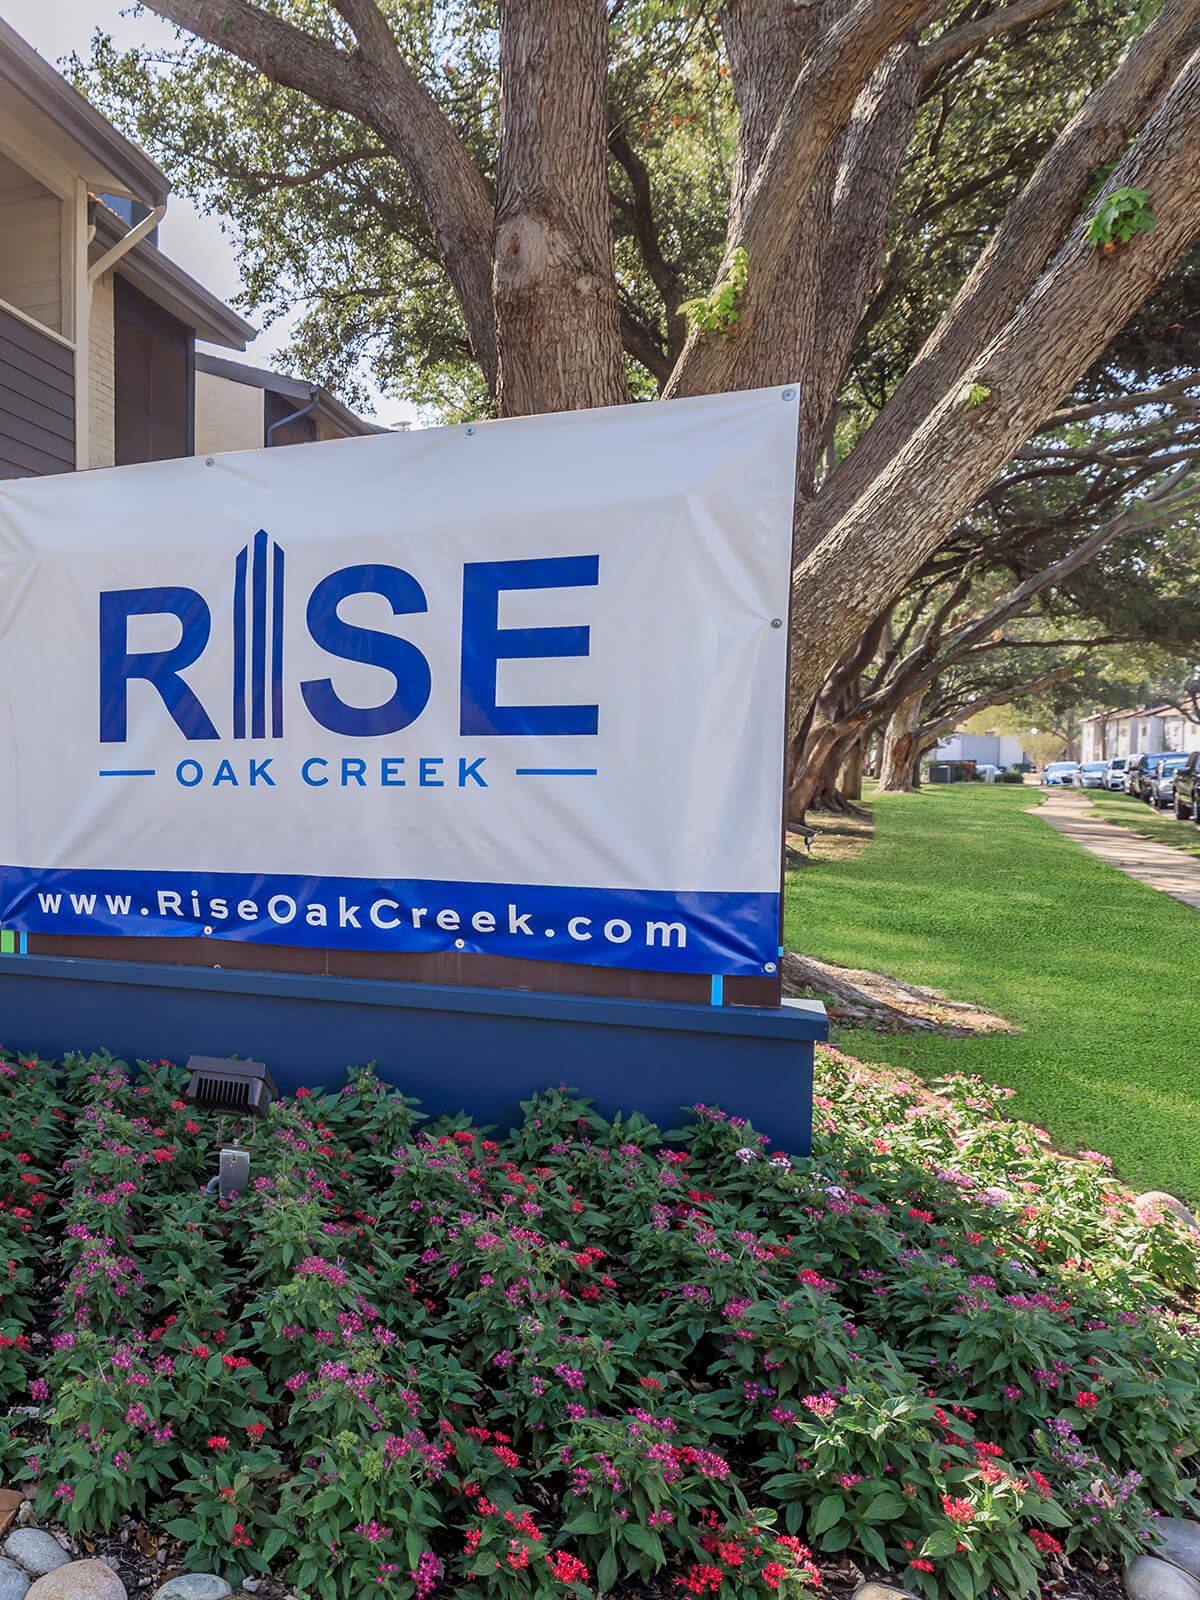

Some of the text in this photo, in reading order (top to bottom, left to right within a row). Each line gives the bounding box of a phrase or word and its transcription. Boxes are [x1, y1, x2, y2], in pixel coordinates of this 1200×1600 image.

[99, 529, 600, 743] RISE
[175, 757, 489, 787] OAK CREEK
[37, 889, 687, 949] www.RiseOakCreek.com
